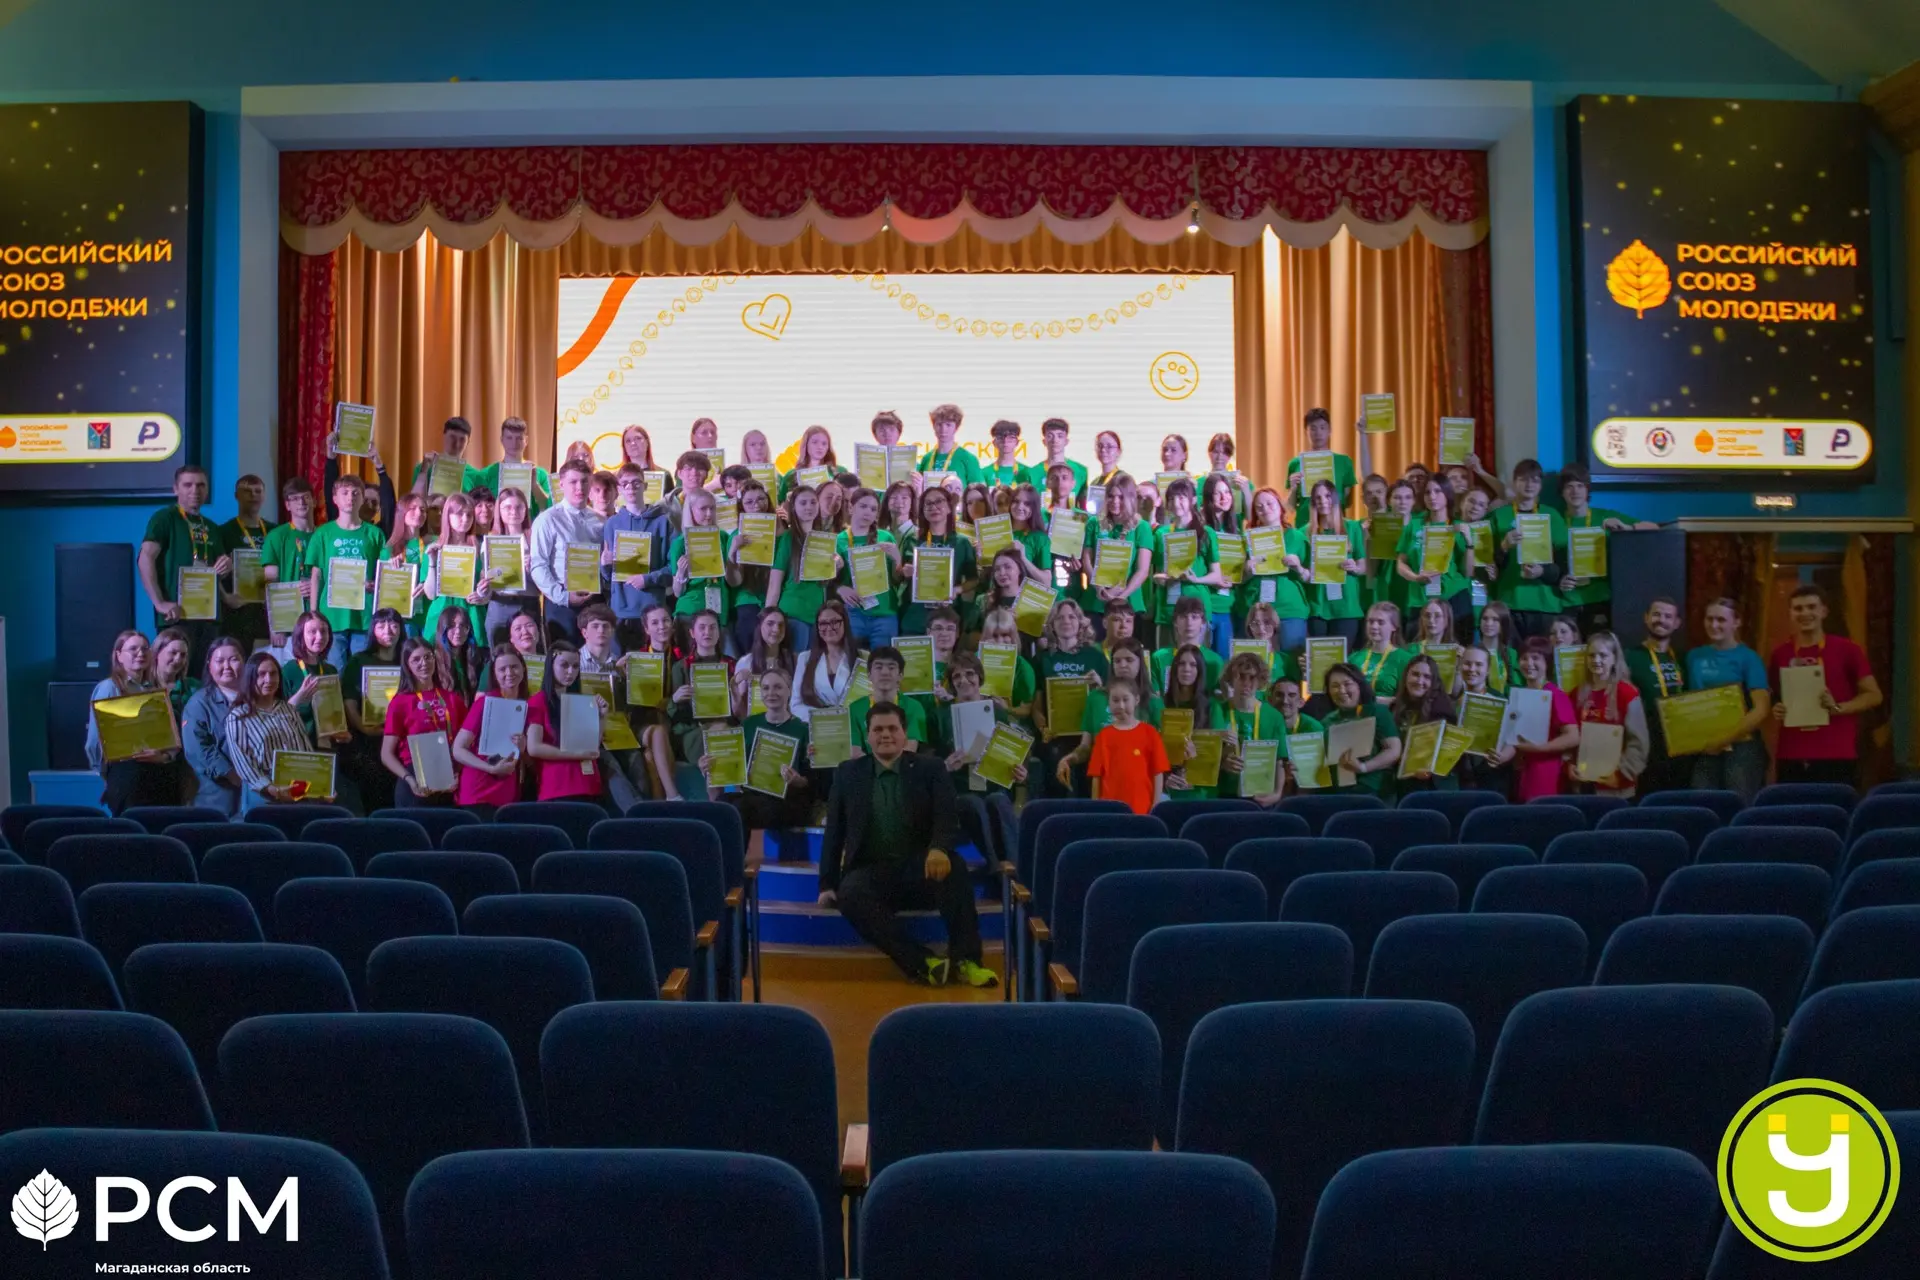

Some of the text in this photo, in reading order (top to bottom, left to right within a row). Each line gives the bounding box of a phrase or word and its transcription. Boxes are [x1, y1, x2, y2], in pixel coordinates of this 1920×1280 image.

[0, 239, 173, 265] ОССИЙСКИЙ
[1676, 241, 1858, 266] РОССИЙСКИЙ
[0, 271, 66, 292] ОЮЗ
[1676, 271, 1757, 292] СОЮЗ
[1678, 299, 1837, 323] МОЛОДЕЖИ
